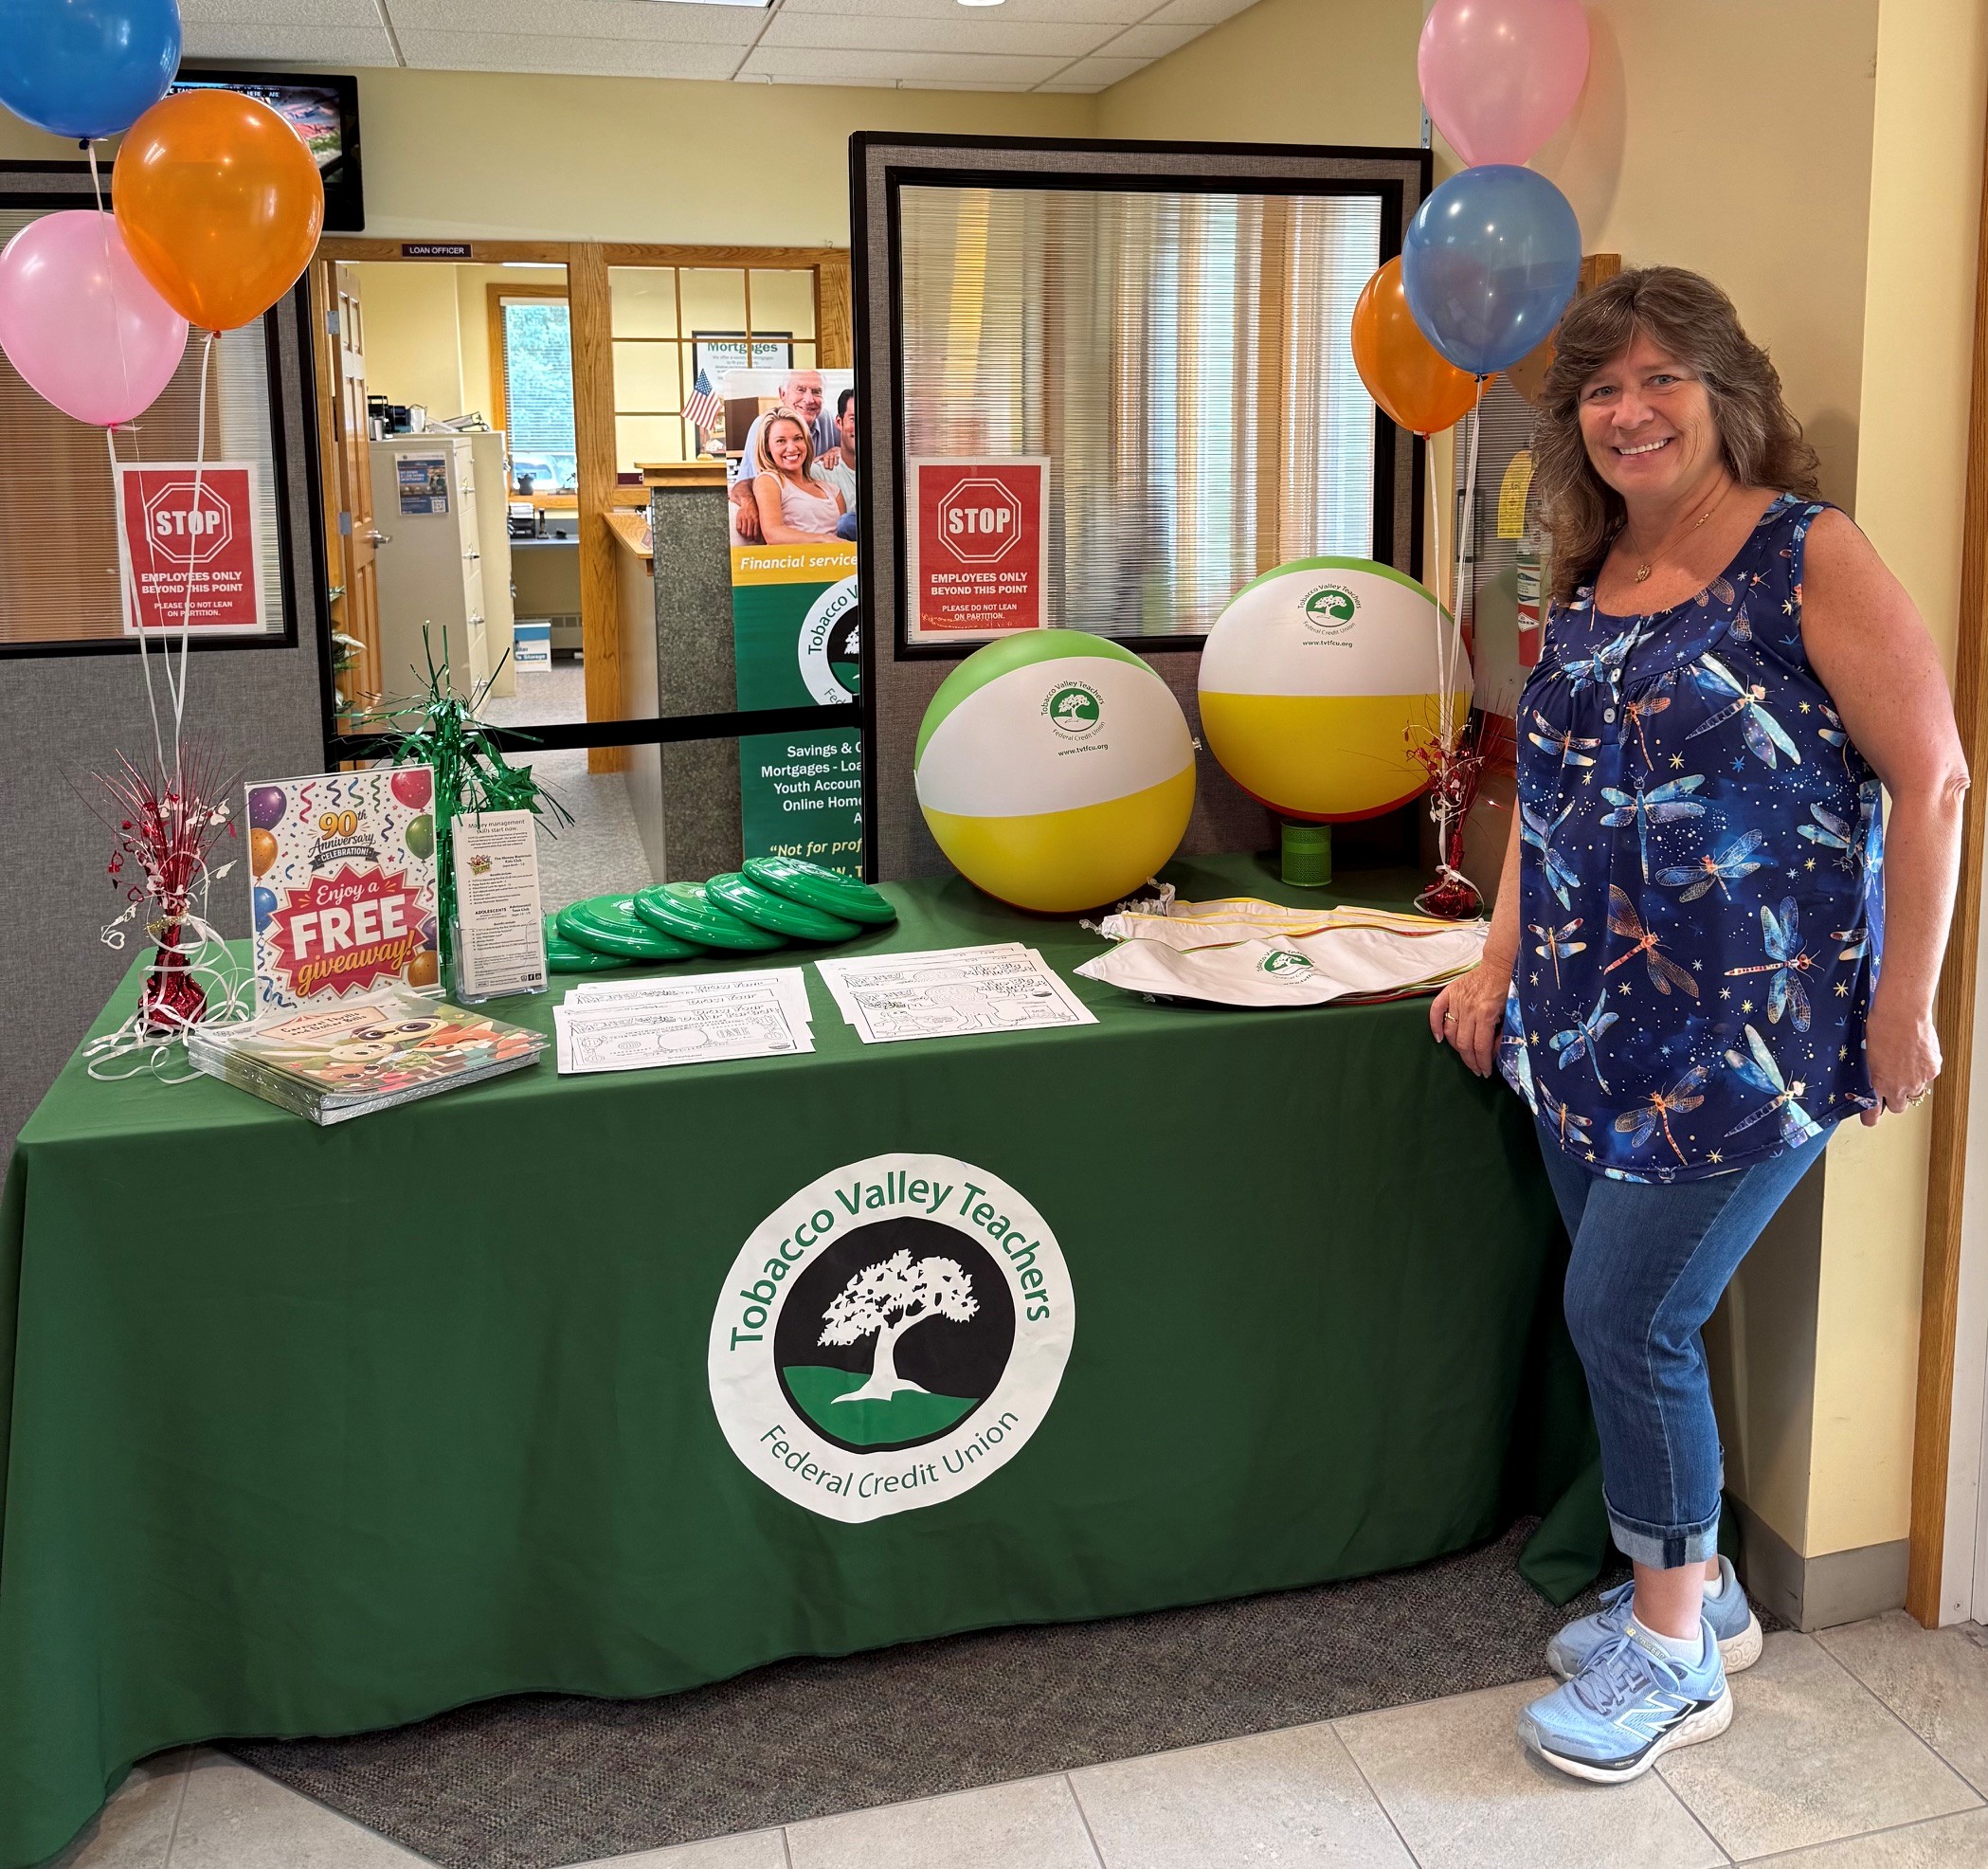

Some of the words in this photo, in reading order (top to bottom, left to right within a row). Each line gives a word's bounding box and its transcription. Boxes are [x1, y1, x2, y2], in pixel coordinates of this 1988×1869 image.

[707, 342, 778, 354] Mortgges
[155, 510, 221, 535] STOP
[949, 507, 1011, 535] STOP
[740, 555, 804, 571] Financial
[141, 572, 210, 583] EMPLOYEES
[211, 571, 243, 581] ONLY
[931, 572, 996, 584] EMPLOYEES
[999, 572, 1028, 582] ONLY
[142, 584, 185, 594] BEYOND
[212, 583, 244, 592] POINT
[931, 587, 972, 595] BEYOND
[973, 586, 996, 594] THIS
[998, 585, 1028, 593] POINT
[154, 601, 183, 609] PLEASE
[1297, 588, 1318, 608] Tobacco
[1342, 585, 1362, 609] Teachers
[967, 612, 1005, 621] PARTITION.
[807, 595, 848, 656] Tobacco
[1303, 620, 1321, 634] Federal
[1339, 622, 1356, 633] Union
[1302, 640, 1353, 648] www.tvtfcu.org
[1040, 688, 1057, 717] Tobacco
[1055, 680, 1078, 691] Valley
[1079, 680, 1105, 705] Teachers
[1052, 728, 1074, 741] Federal
[1074, 733, 1093, 742] Credit
[1092, 720, 1106, 735] Union
[786, 744, 838, 758] Savings
[840, 742, 852, 754] &
[1057, 743, 1109, 756] www.tvtfcu.org
[761, 763, 830, 778] Mortgages
[773, 780, 810, 795] Youth
[814, 778, 861, 791] Accoun
[783, 798, 824, 812] Online
[488, 819, 525, 827] management
[308, 832, 376, 859] Anniversary
[806, 841, 828, 857] for
[321, 846, 370, 862] CELEBRATION!
[316, 883, 365, 906] Enjoy
[367, 880, 380, 894] a
[289, 894, 408, 961] FREE
[296, 929, 415, 998] giveaway!
[280, 1016, 326, 1033] Carnival
[731, 1209, 835, 1352] Tobacco
[835, 1170, 953, 1216] Valley
[959, 1182, 1050, 1322] Teachers
[759, 1424, 854, 1497] Federal
[858, 1464, 939, 1498] Credit
[942, 1409, 1019, 1474] Union
